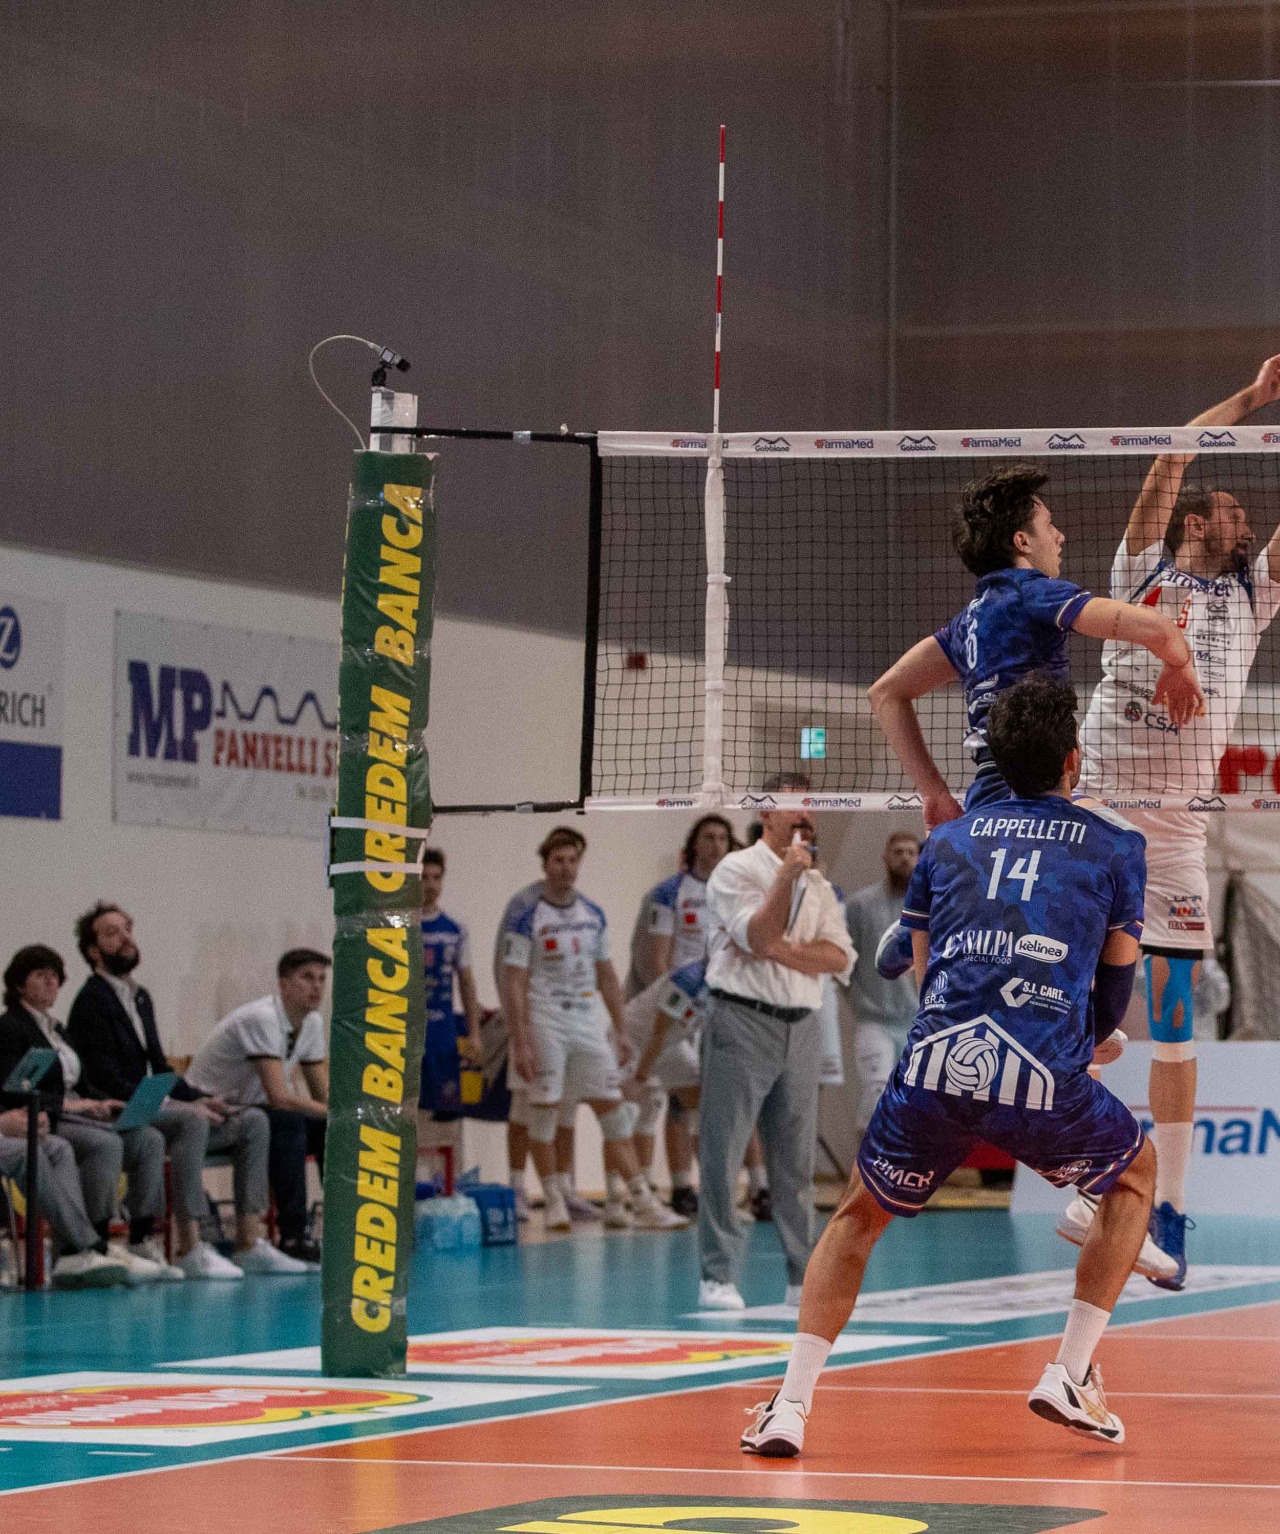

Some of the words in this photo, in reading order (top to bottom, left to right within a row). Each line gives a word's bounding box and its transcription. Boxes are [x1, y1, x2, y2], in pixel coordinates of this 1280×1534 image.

[814, 438, 874, 449] FarmaMed
[900, 444, 936, 452] Gabbiano
[961, 436, 1021, 448] FarmaMed
[1049, 441, 1085, 450] Gabbiano
[1110, 434, 1172, 446] FarmaMed
[1199, 439, 1237, 448] Gabbiano
[375, 483, 424, 667] BANCA
[127, 659, 213, 764] MP
[1144, 711, 1179, 736] CSA
[213, 728, 319, 776] PANNELLI
[364, 684, 411, 893] CREDEM
[802, 797, 862, 808] FarmaMed
[1188, 804, 1225, 812] Gabbiano
[970, 818, 1087, 844] CAPPELLETTI
[987, 848, 1042, 901] 14
[962, 929, 1014, 958] SALPA
[1018, 940, 1063, 957] kèlinea
[963, 955, 989, 964] SPECIAL
[990, 957, 1012, 965] FOOD
[362, 927, 409, 1104] BANCA
[351, 1125, 402, 1333] CREDEM
